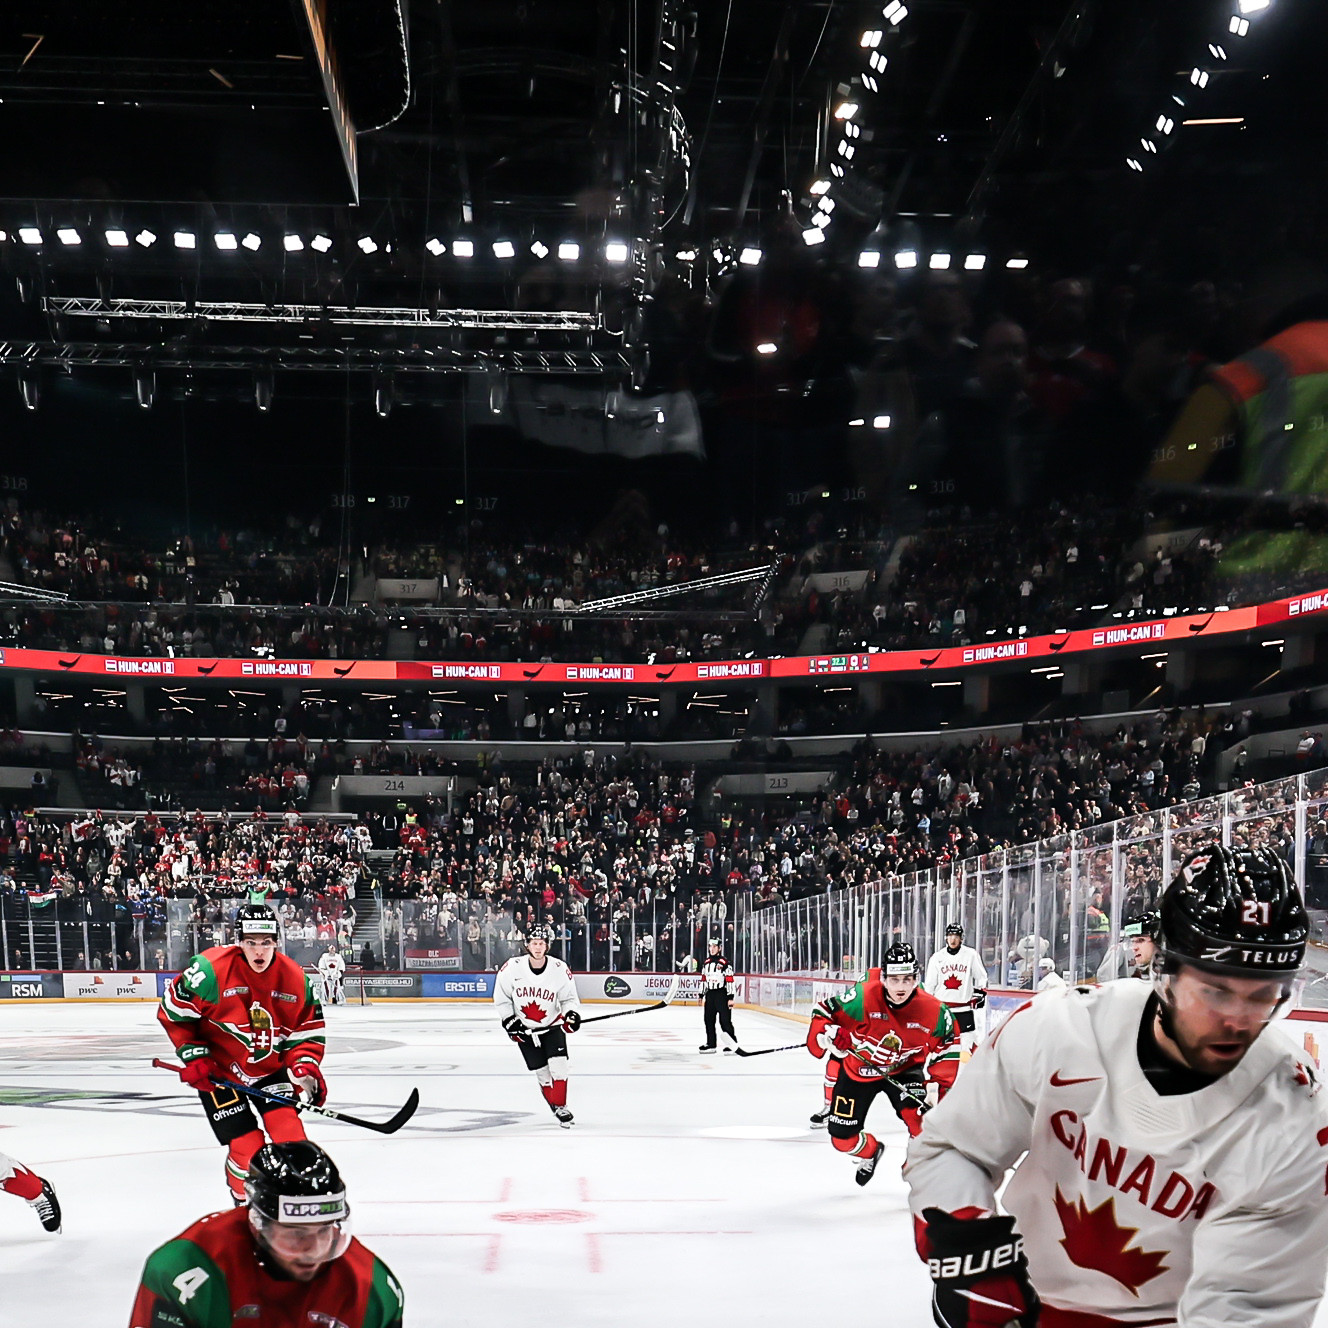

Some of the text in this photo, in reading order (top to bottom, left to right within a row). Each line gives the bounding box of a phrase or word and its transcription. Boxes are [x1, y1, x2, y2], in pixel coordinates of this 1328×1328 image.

[1, 474, 27, 491] 318
[928, 479, 955, 494] 316
[842, 487, 866, 501] 316
[387, 495, 410, 509] 317
[476, 497, 498, 510] 317
[400, 584, 417, 594] 317
[1107, 626, 1150, 643] HUN-CAN
[976, 644, 1014, 660] HUN-CAN
[118, 657, 161, 673] HUN-CAN
[256, 664, 298, 674] HUN-CAN
[446, 666, 487, 677] HUN-CAN
[580, 664, 622, 679] HUN-CAN
[710, 664, 749, 677] HUN-CAN
[384, 780, 405, 791] 214
[769, 778, 788, 788] 213
[1243, 900, 1270, 924] 21
[1241, 950, 1299, 963] TELUS
[183, 961, 207, 989] 24
[940, 965, 968, 974] CANADA
[11, 983, 42, 997] RSM
[78, 986, 98, 996] pwc
[116, 986, 136, 996] pwc
[445, 982, 476, 992] ERSTE
[516, 986, 556, 1003] CANADA
[1050, 1109, 1217, 1223] CANADA
[172, 1266, 210, 1305] 4
